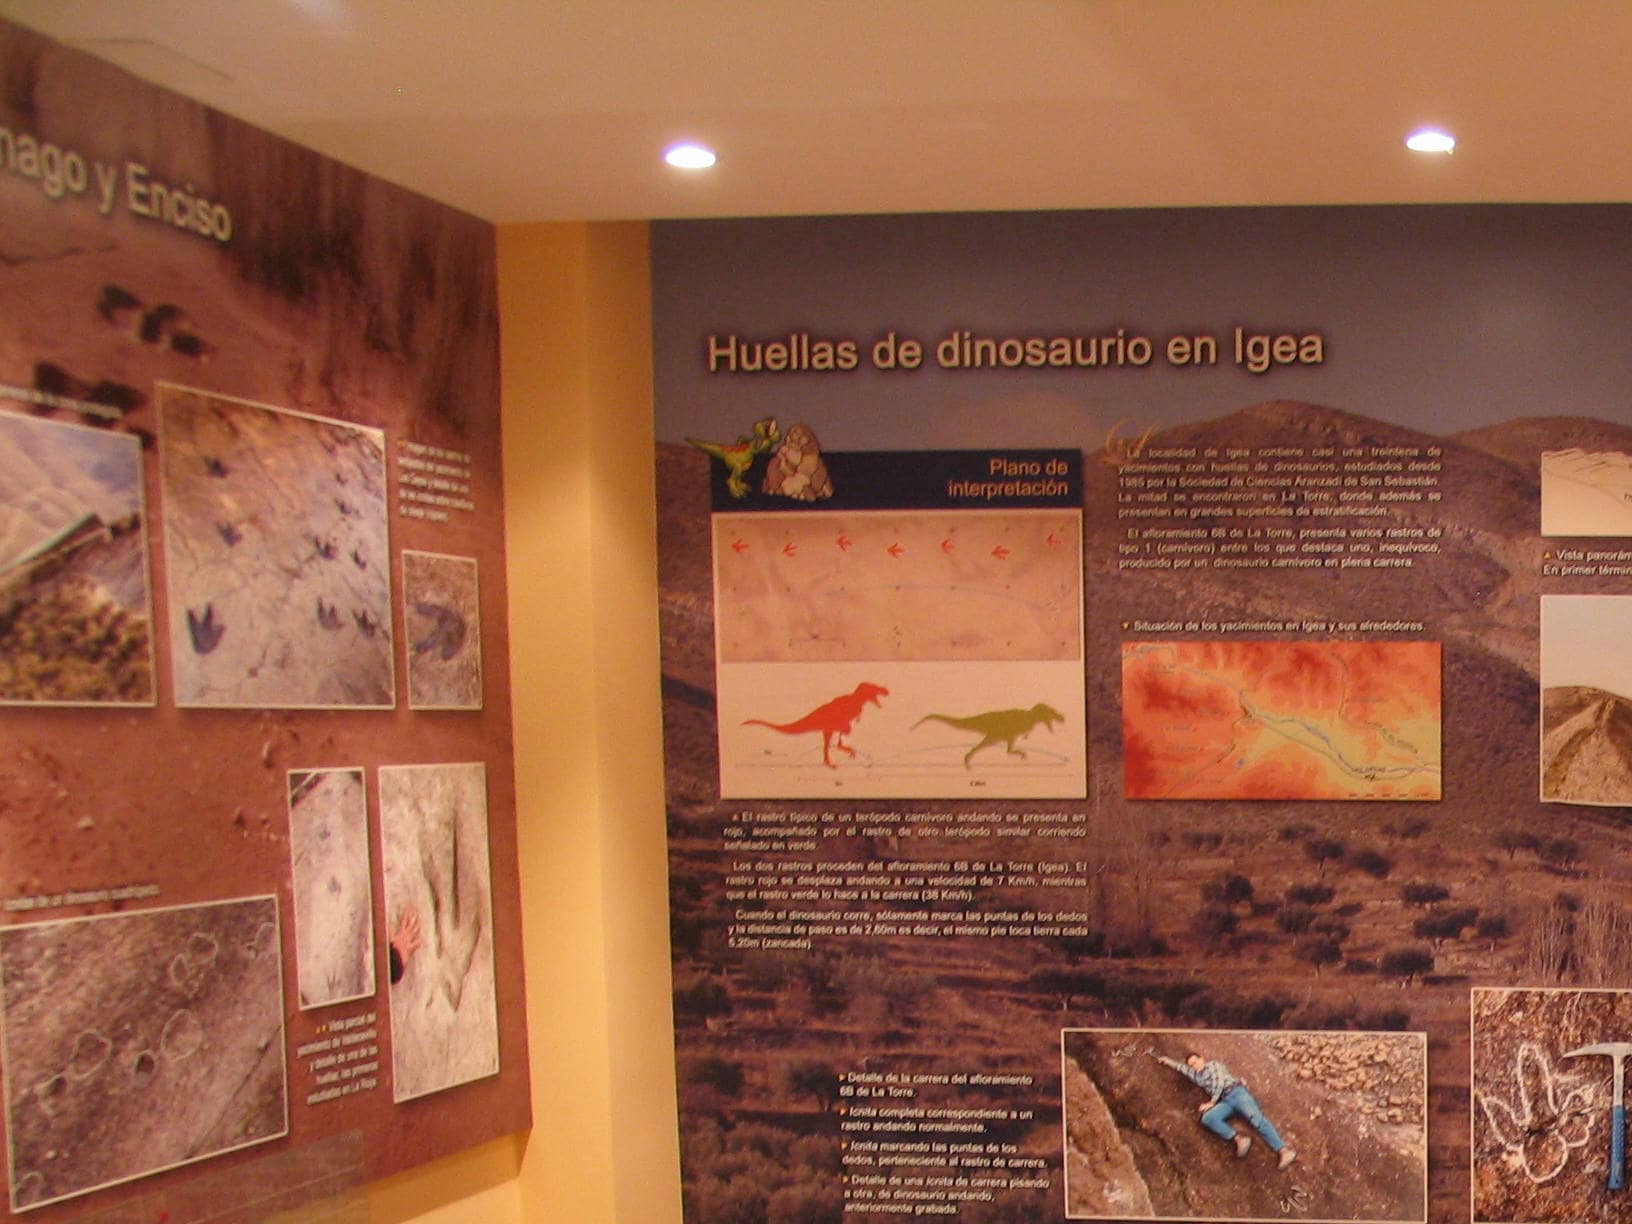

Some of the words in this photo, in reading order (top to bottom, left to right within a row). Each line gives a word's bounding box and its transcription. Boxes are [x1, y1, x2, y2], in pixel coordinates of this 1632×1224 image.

[95, 161, 118, 214] y
[126, 161, 233, 241] Enciso
[708, 333, 858, 371] Huellas
[872, 332, 923, 369] de
[937, 328, 1152, 368] dinosaurio
[1166, 336, 1216, 365] en
[1234, 327, 1324, 373] Igea
[990, 458, 1041, 476] Plano
[1045, 458, 1068, 476] de
[948, 479, 1069, 500] interpretación
